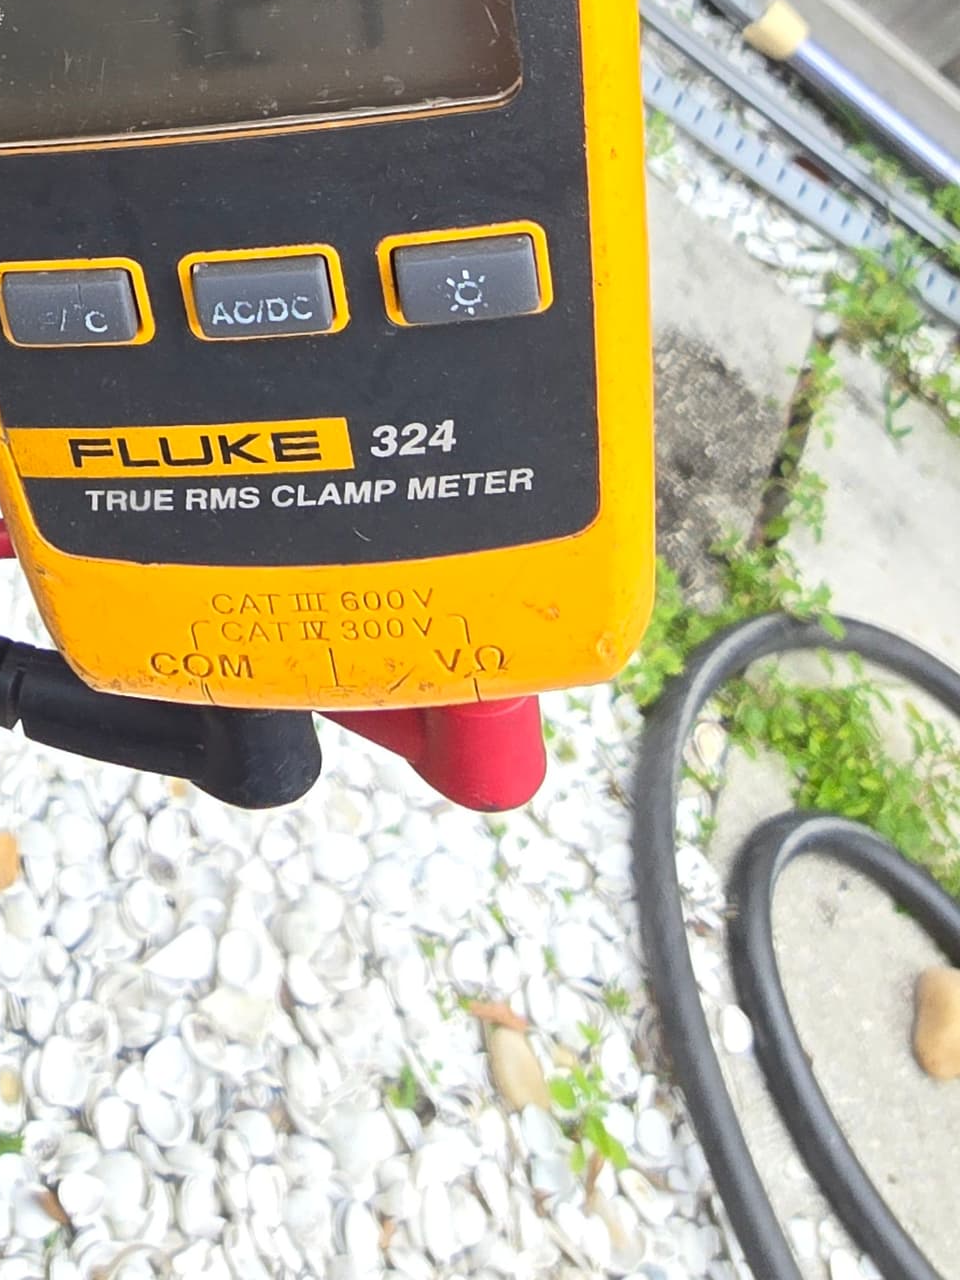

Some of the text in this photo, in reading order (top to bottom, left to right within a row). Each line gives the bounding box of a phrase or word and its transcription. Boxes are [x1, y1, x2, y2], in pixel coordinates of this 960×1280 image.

[212, 296, 313, 326] AC/DC
[69, 419, 457, 468] FLUKE 324
[86, 467, 535, 511] TRUE RMS CLAMP METER
[211, 593, 281, 616] CAT
[288, 592, 329, 613] III
[220, 622, 290, 643] CAT
[150, 652, 255, 680] COM
